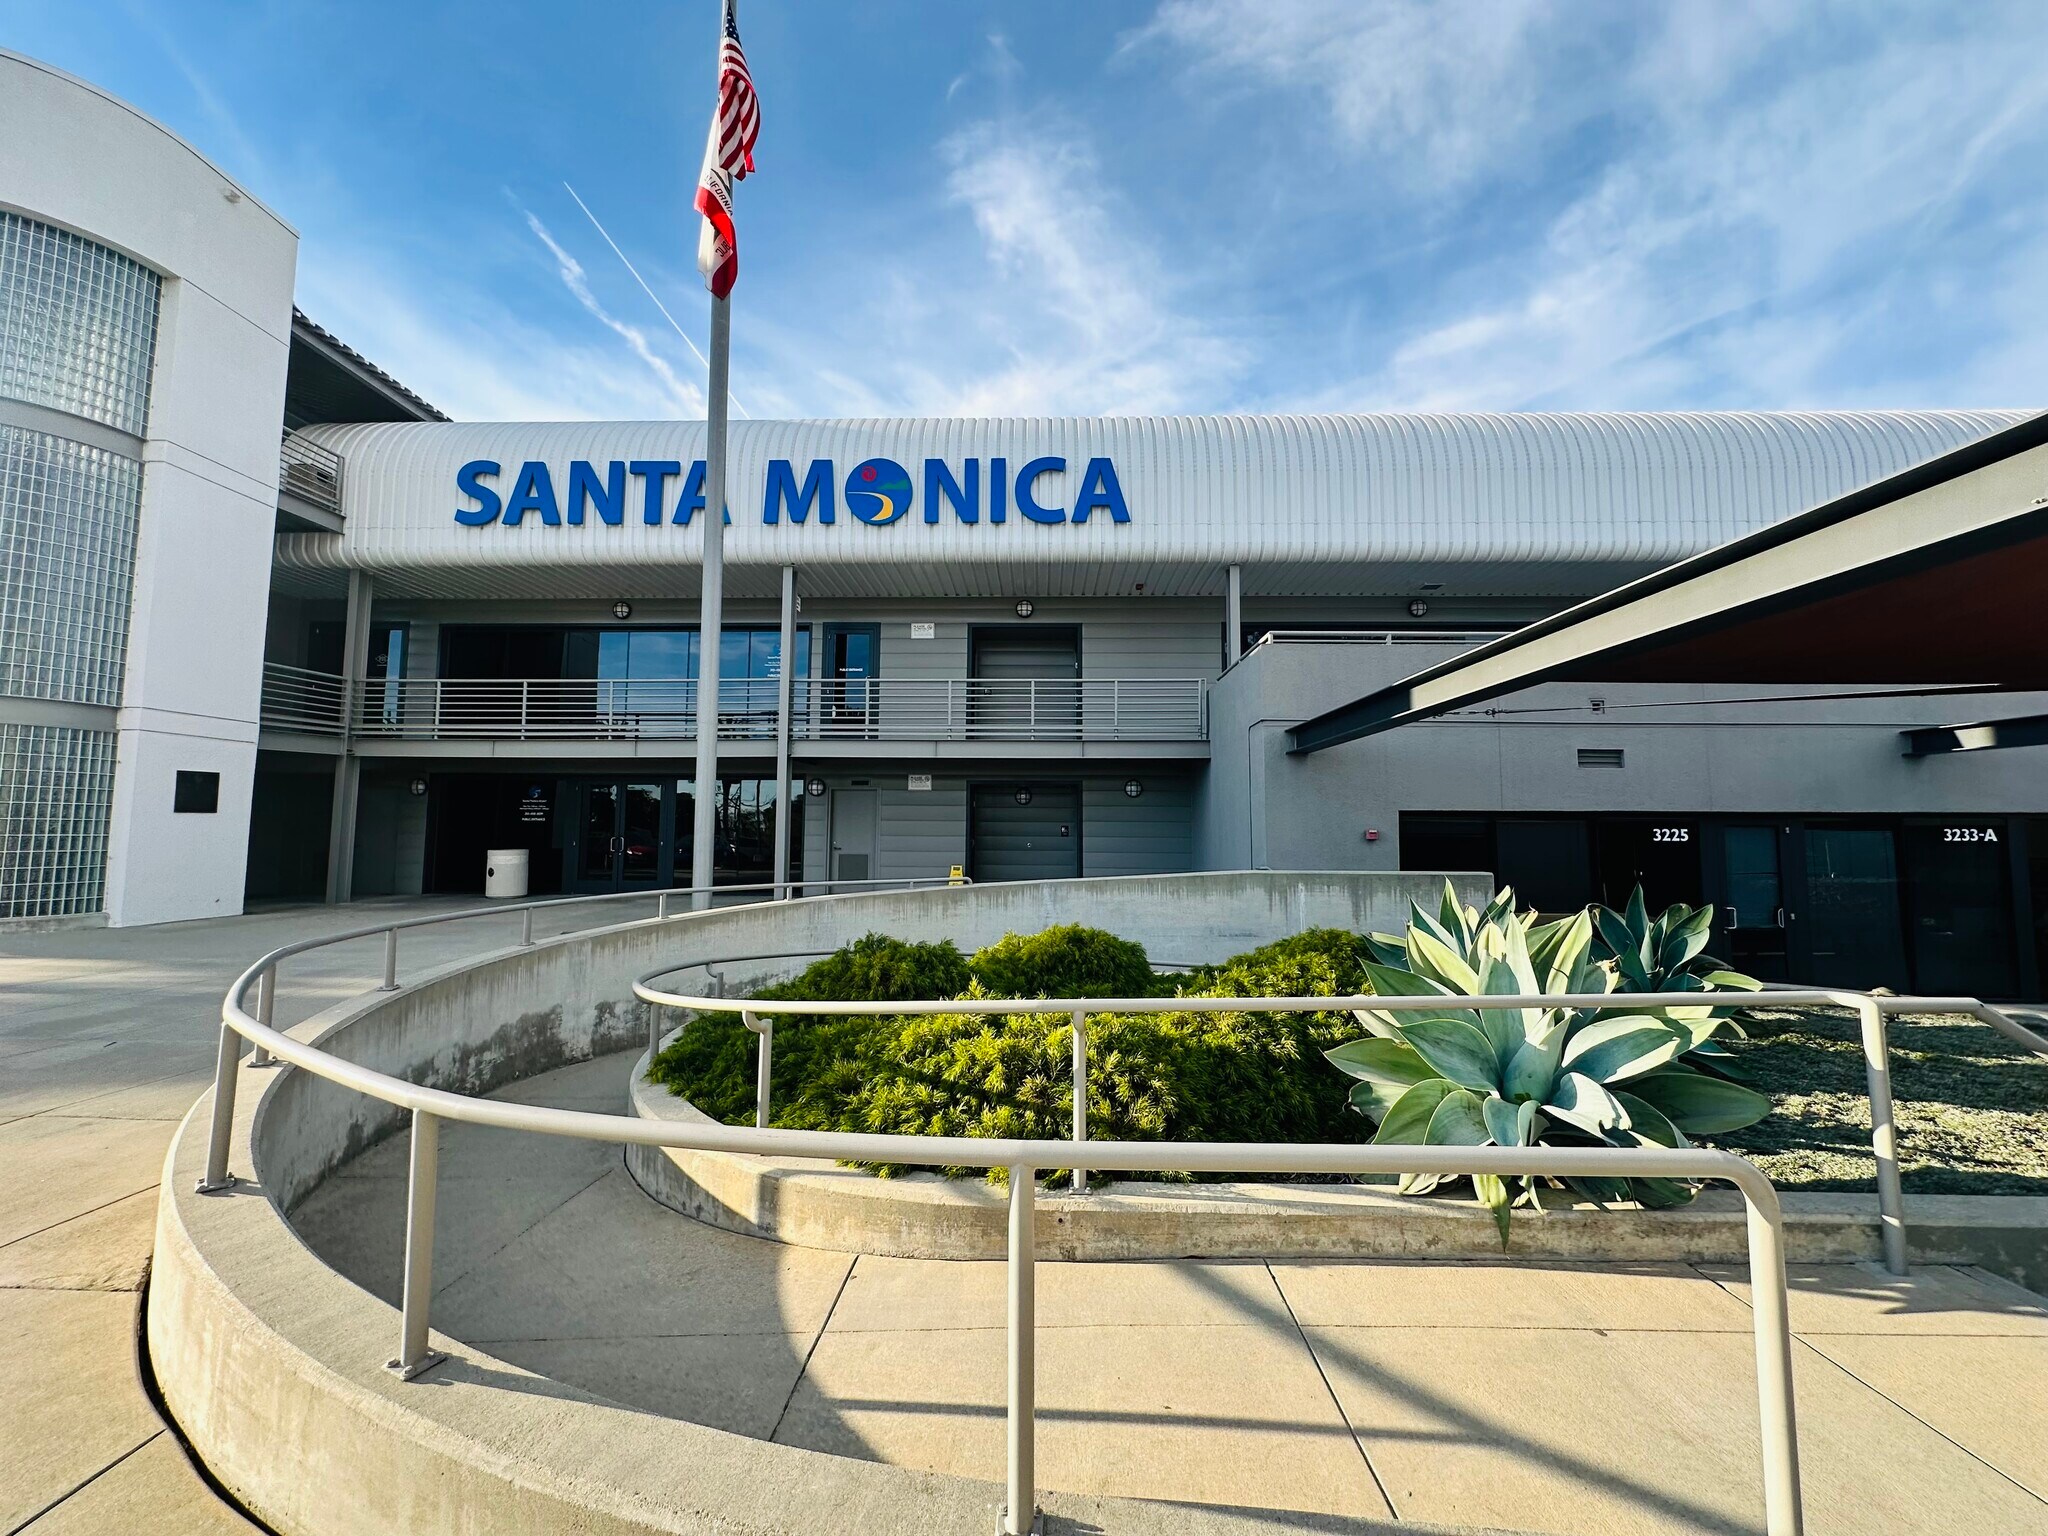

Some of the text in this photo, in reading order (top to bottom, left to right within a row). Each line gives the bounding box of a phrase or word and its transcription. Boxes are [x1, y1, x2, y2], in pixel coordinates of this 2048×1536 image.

[455, 457, 1131, 526] SANTA MONICA
[1653, 828, 1689, 842] 3225
[1943, 828, 1998, 842] 3233-A
